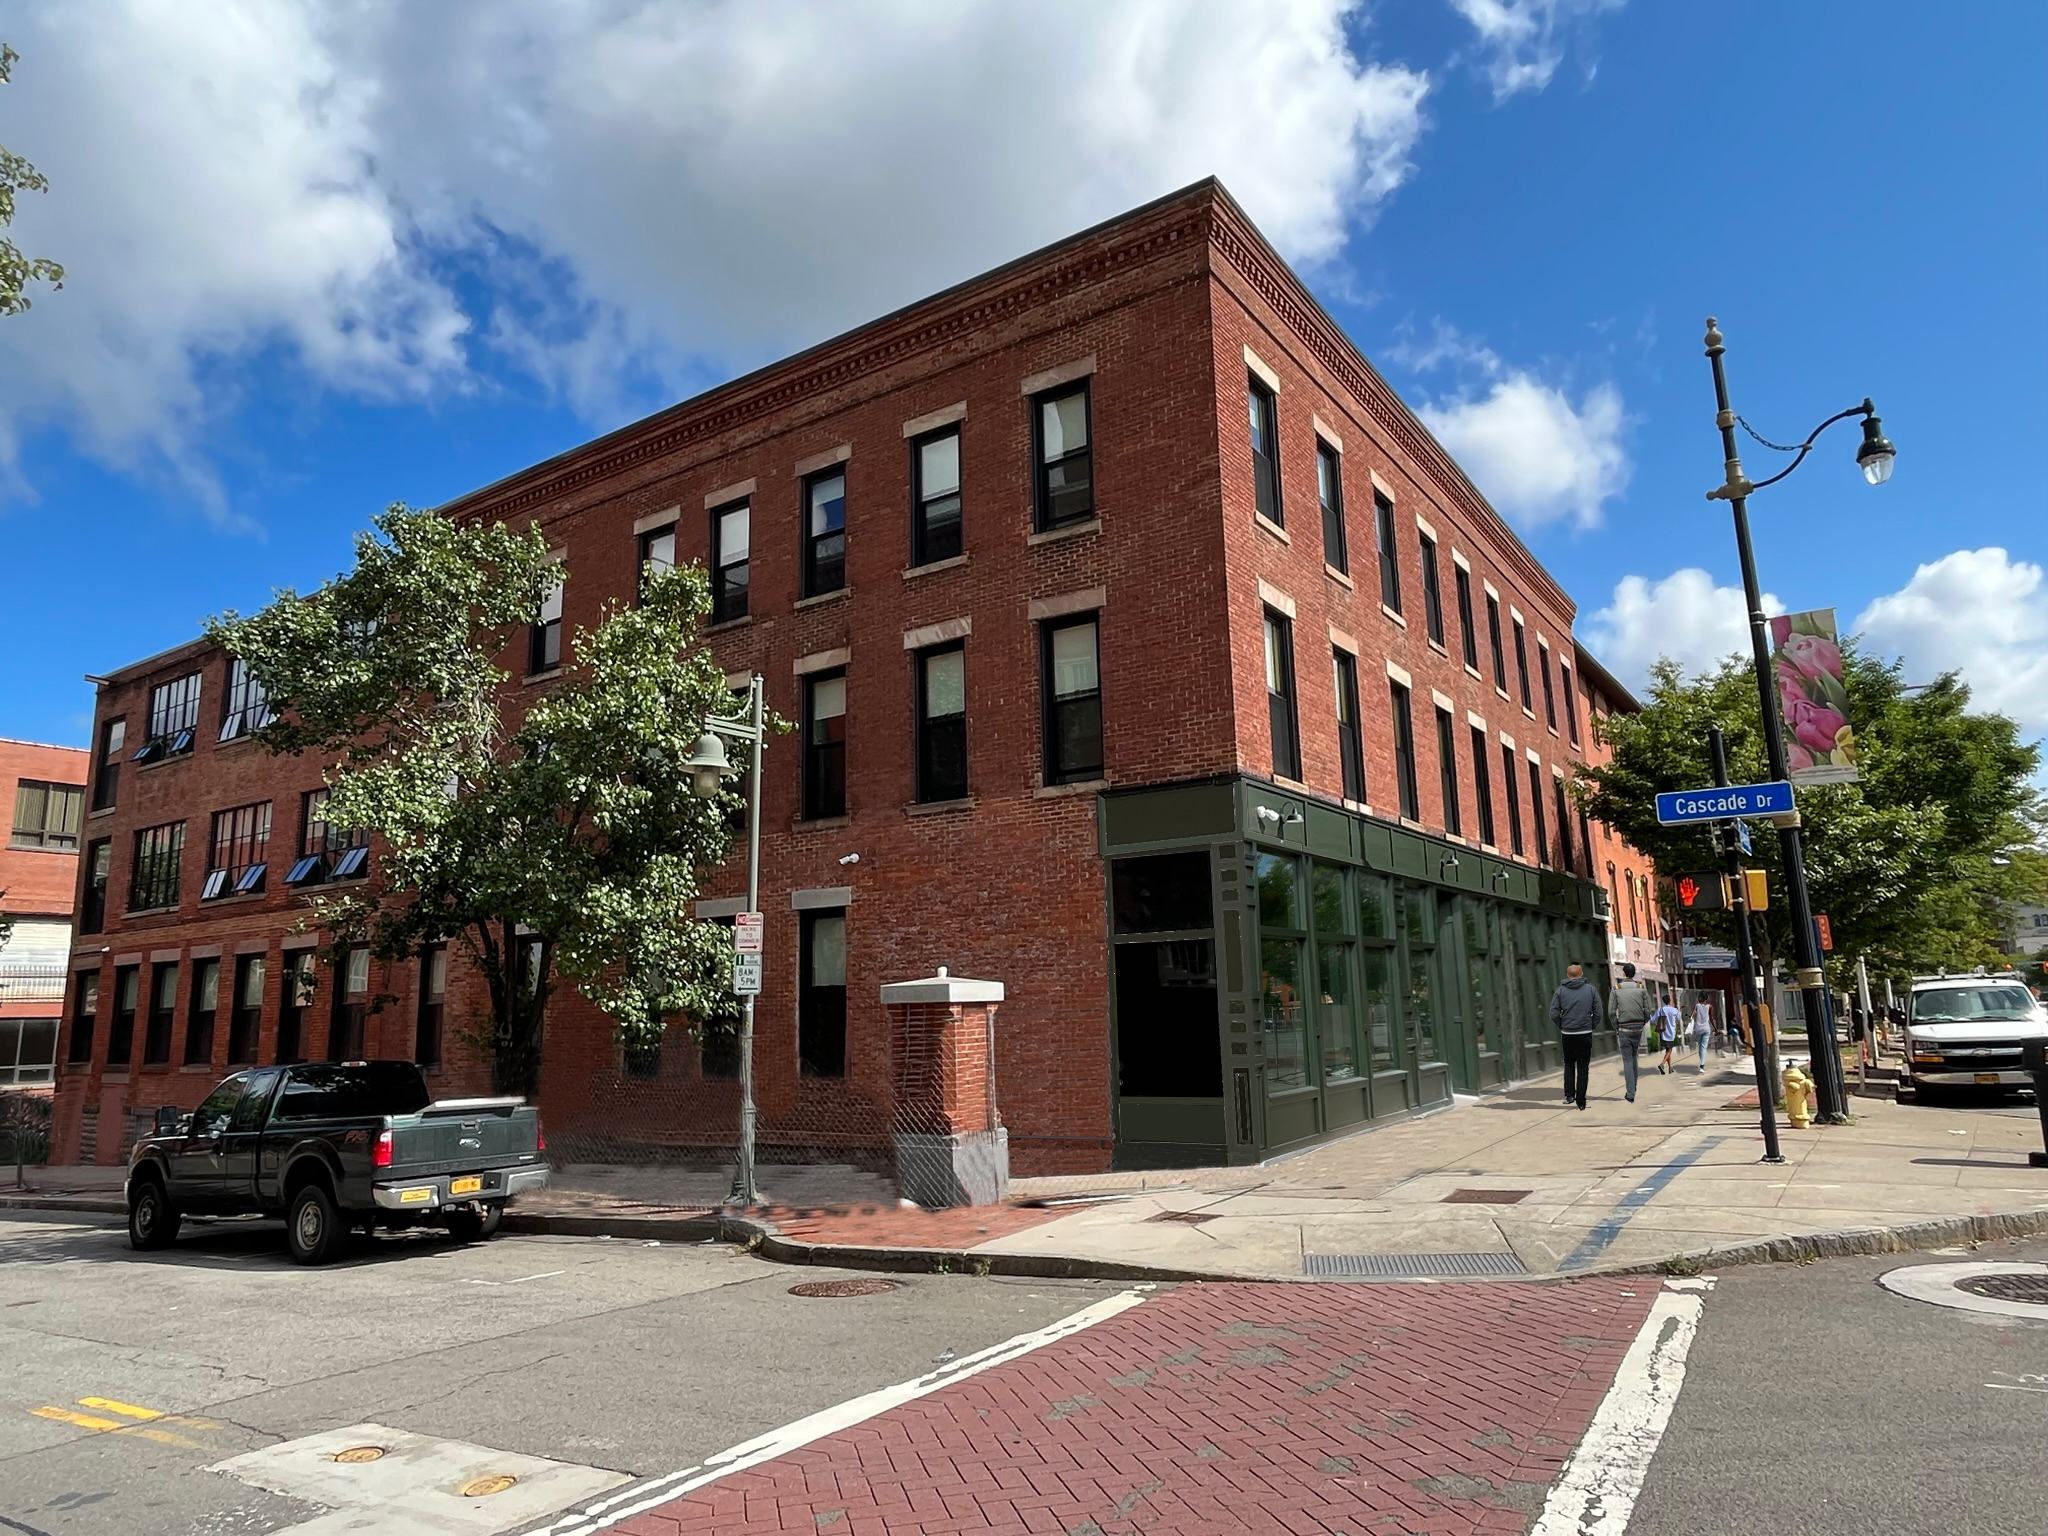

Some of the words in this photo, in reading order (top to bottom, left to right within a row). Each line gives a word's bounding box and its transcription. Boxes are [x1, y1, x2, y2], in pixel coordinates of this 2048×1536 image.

[1675, 794, 1747, 815] Cascade
[1756, 795, 1773, 808] Dr
[737, 916, 746, 924] NO
[740, 976, 756, 986] 5PM
